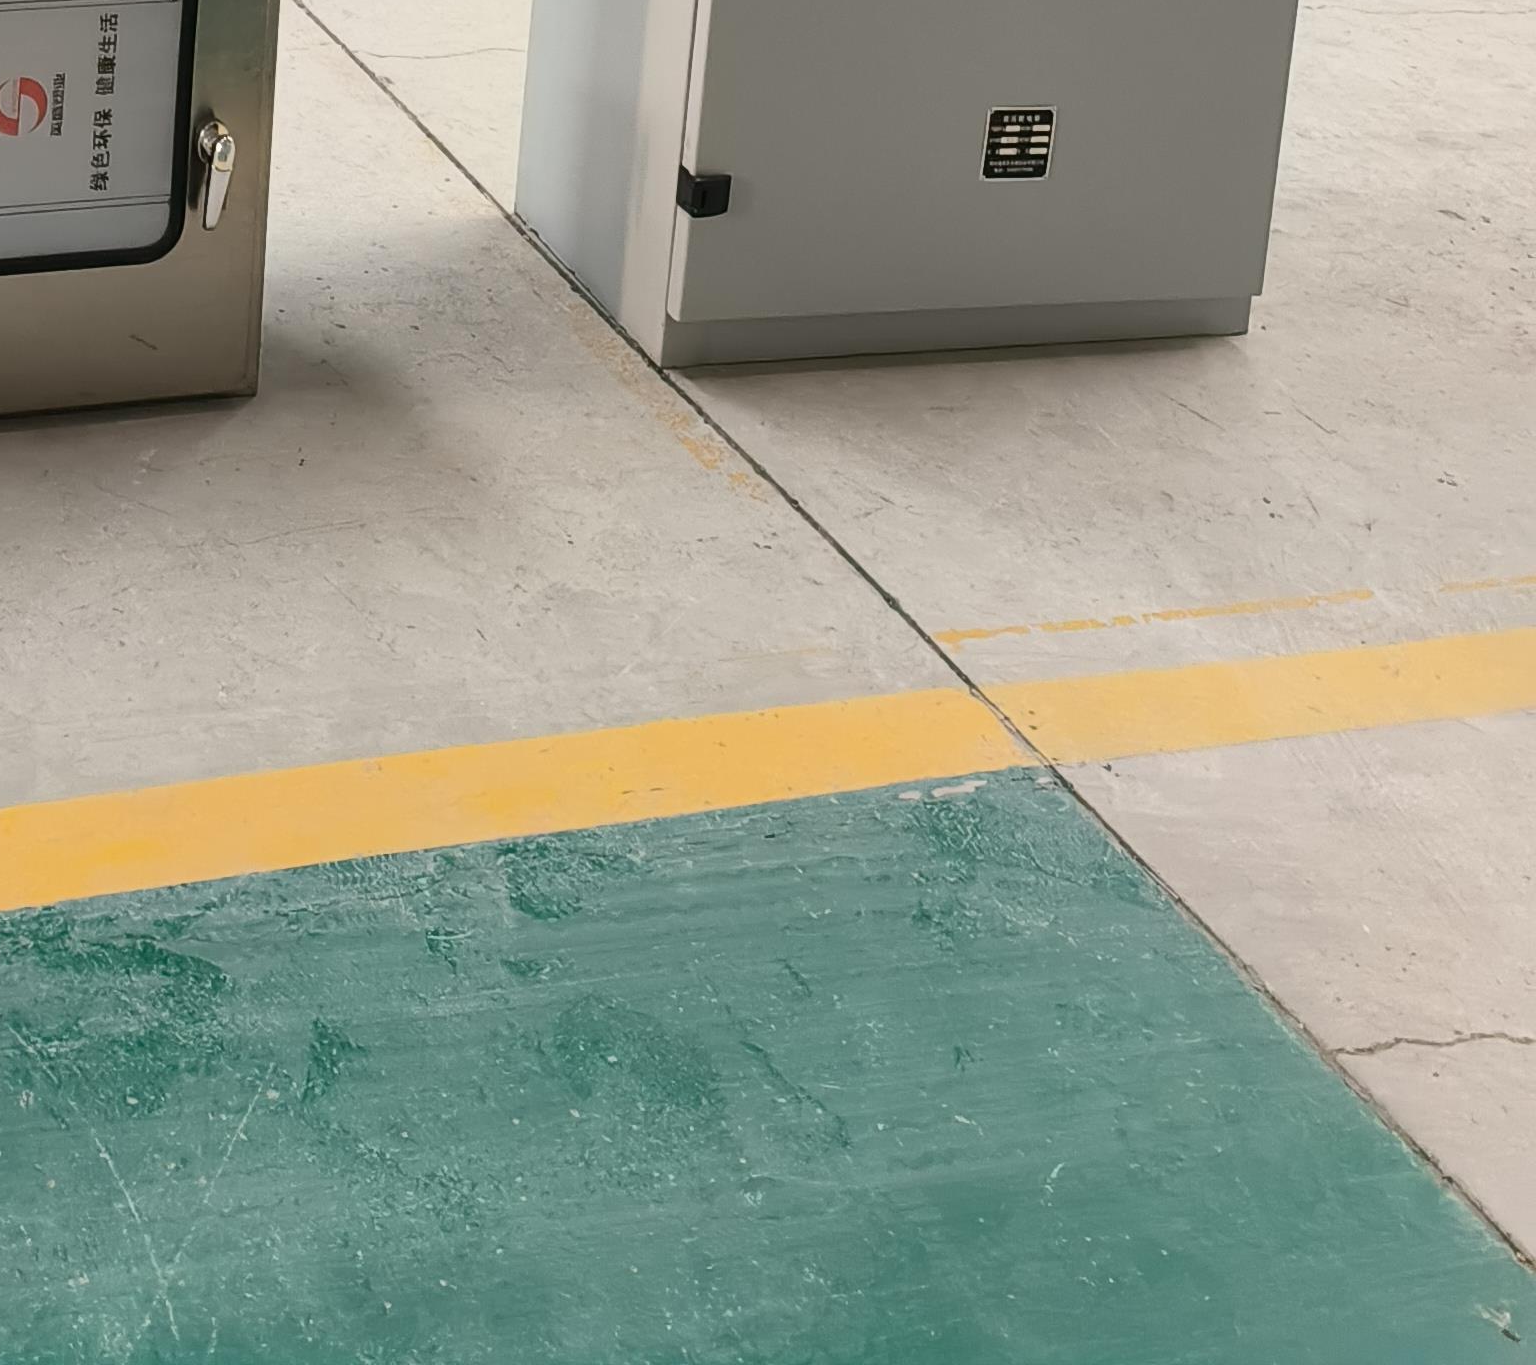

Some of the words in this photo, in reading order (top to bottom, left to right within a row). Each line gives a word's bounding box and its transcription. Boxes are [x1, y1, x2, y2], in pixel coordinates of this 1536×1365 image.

[95, 13, 119, 96] 健康生活
[89, 108, 113, 191] 绿色环保
